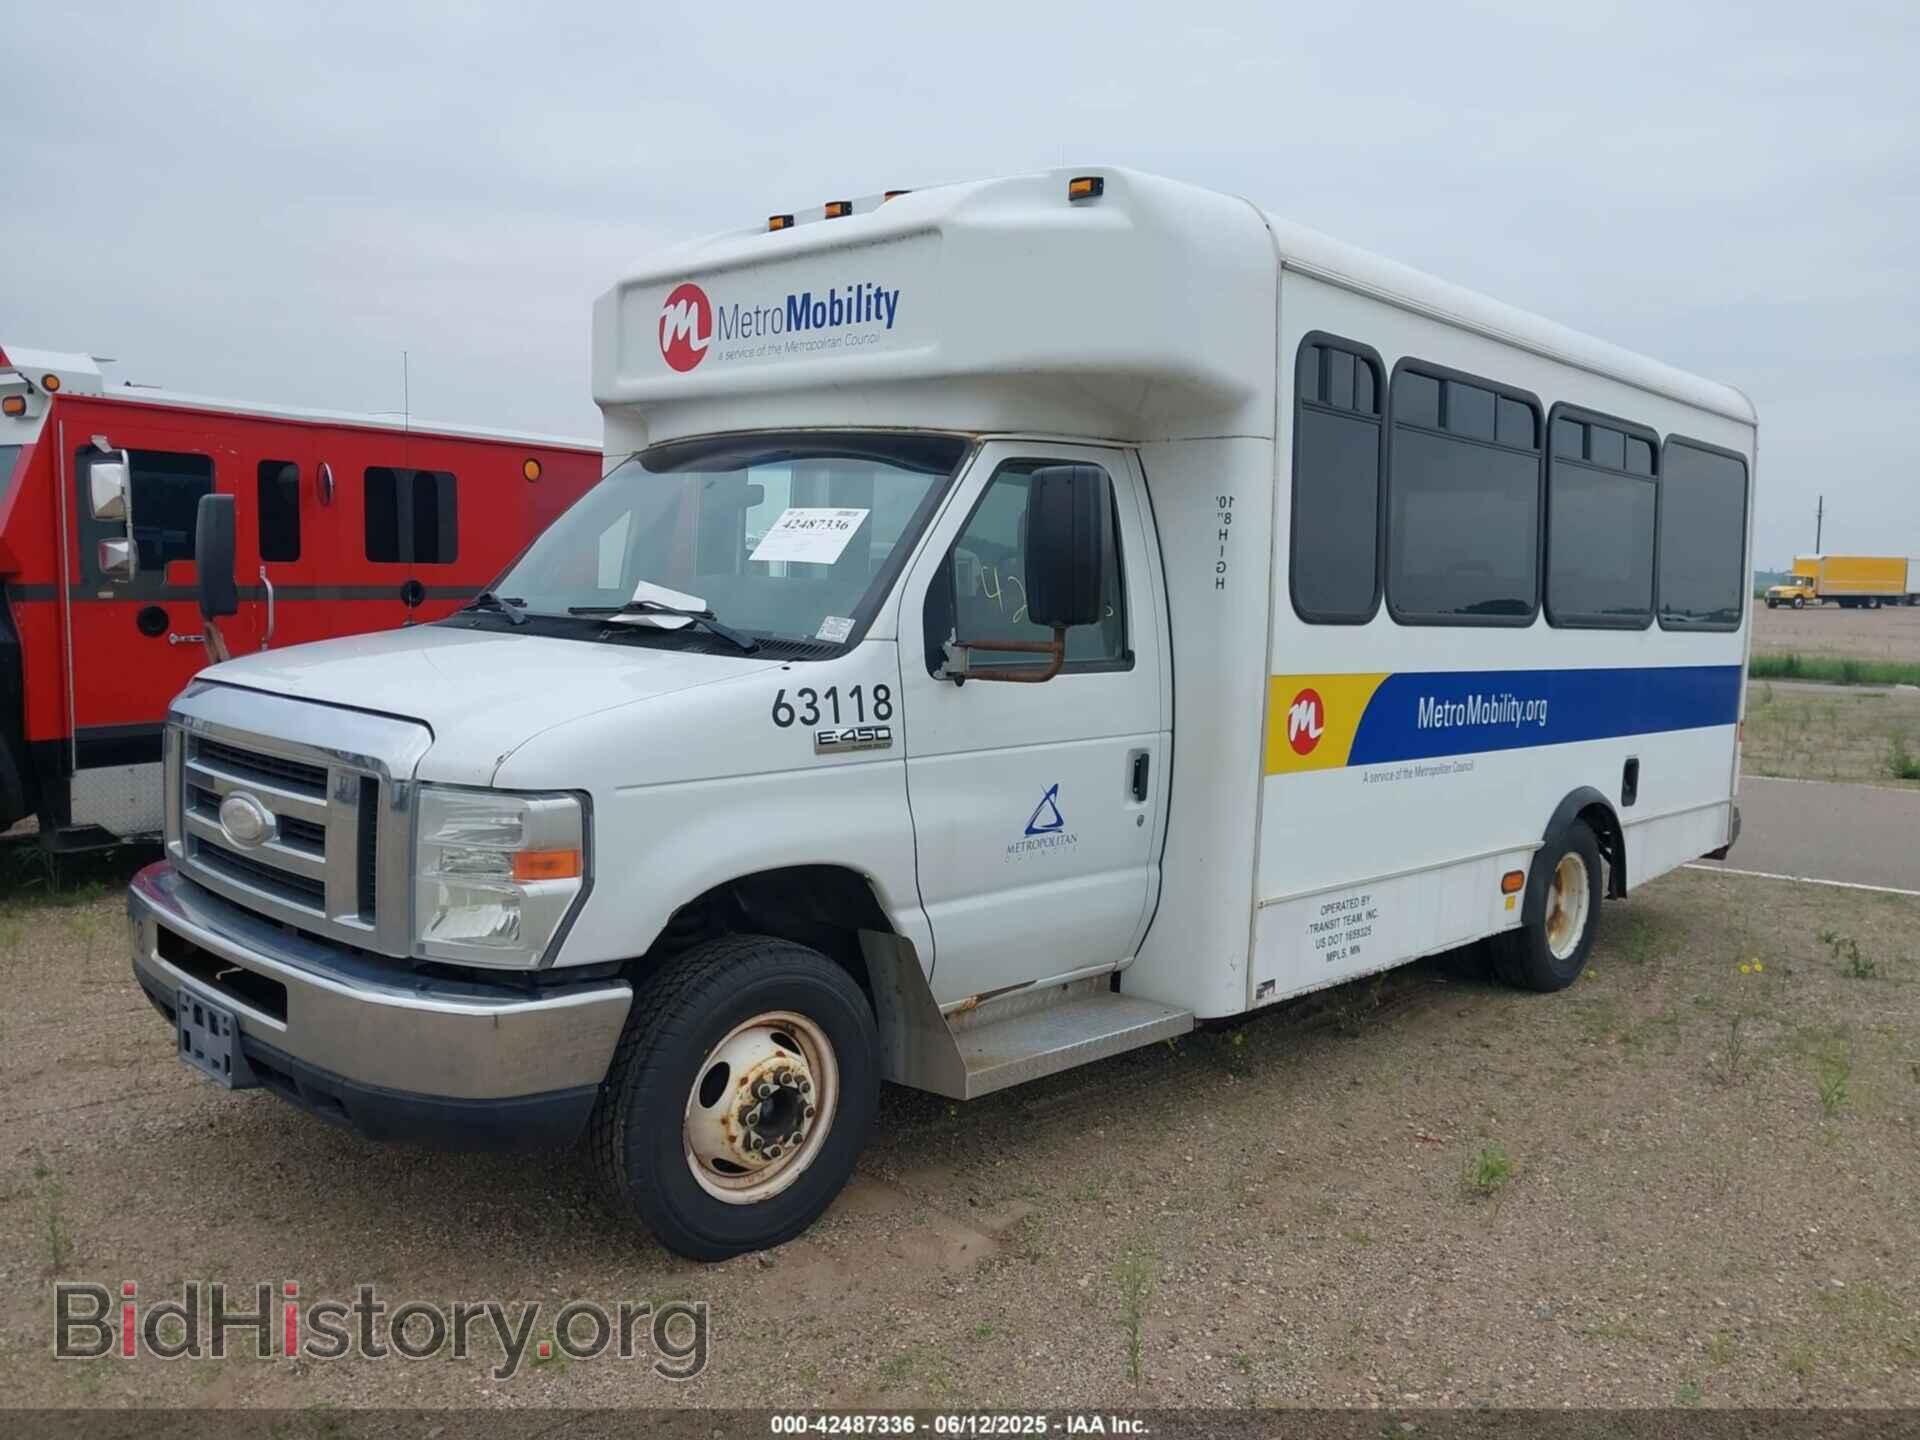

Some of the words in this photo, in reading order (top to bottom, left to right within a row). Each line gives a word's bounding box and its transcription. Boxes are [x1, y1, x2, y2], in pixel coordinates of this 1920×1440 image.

[717, 283, 900, 342] MetroMobility
[784, 335, 843, 354] Metropolitan
[782, 519, 849, 530] 42487336
[772, 684, 893, 728] 63118
[1417, 693, 1548, 729] MetroMobility.org
[1320, 897, 1360, 916] OPERATED
[1309, 917, 1341, 935] TRANSIT
[1315, 937, 1327, 950] US
[1327, 933, 1344, 946] DOT
